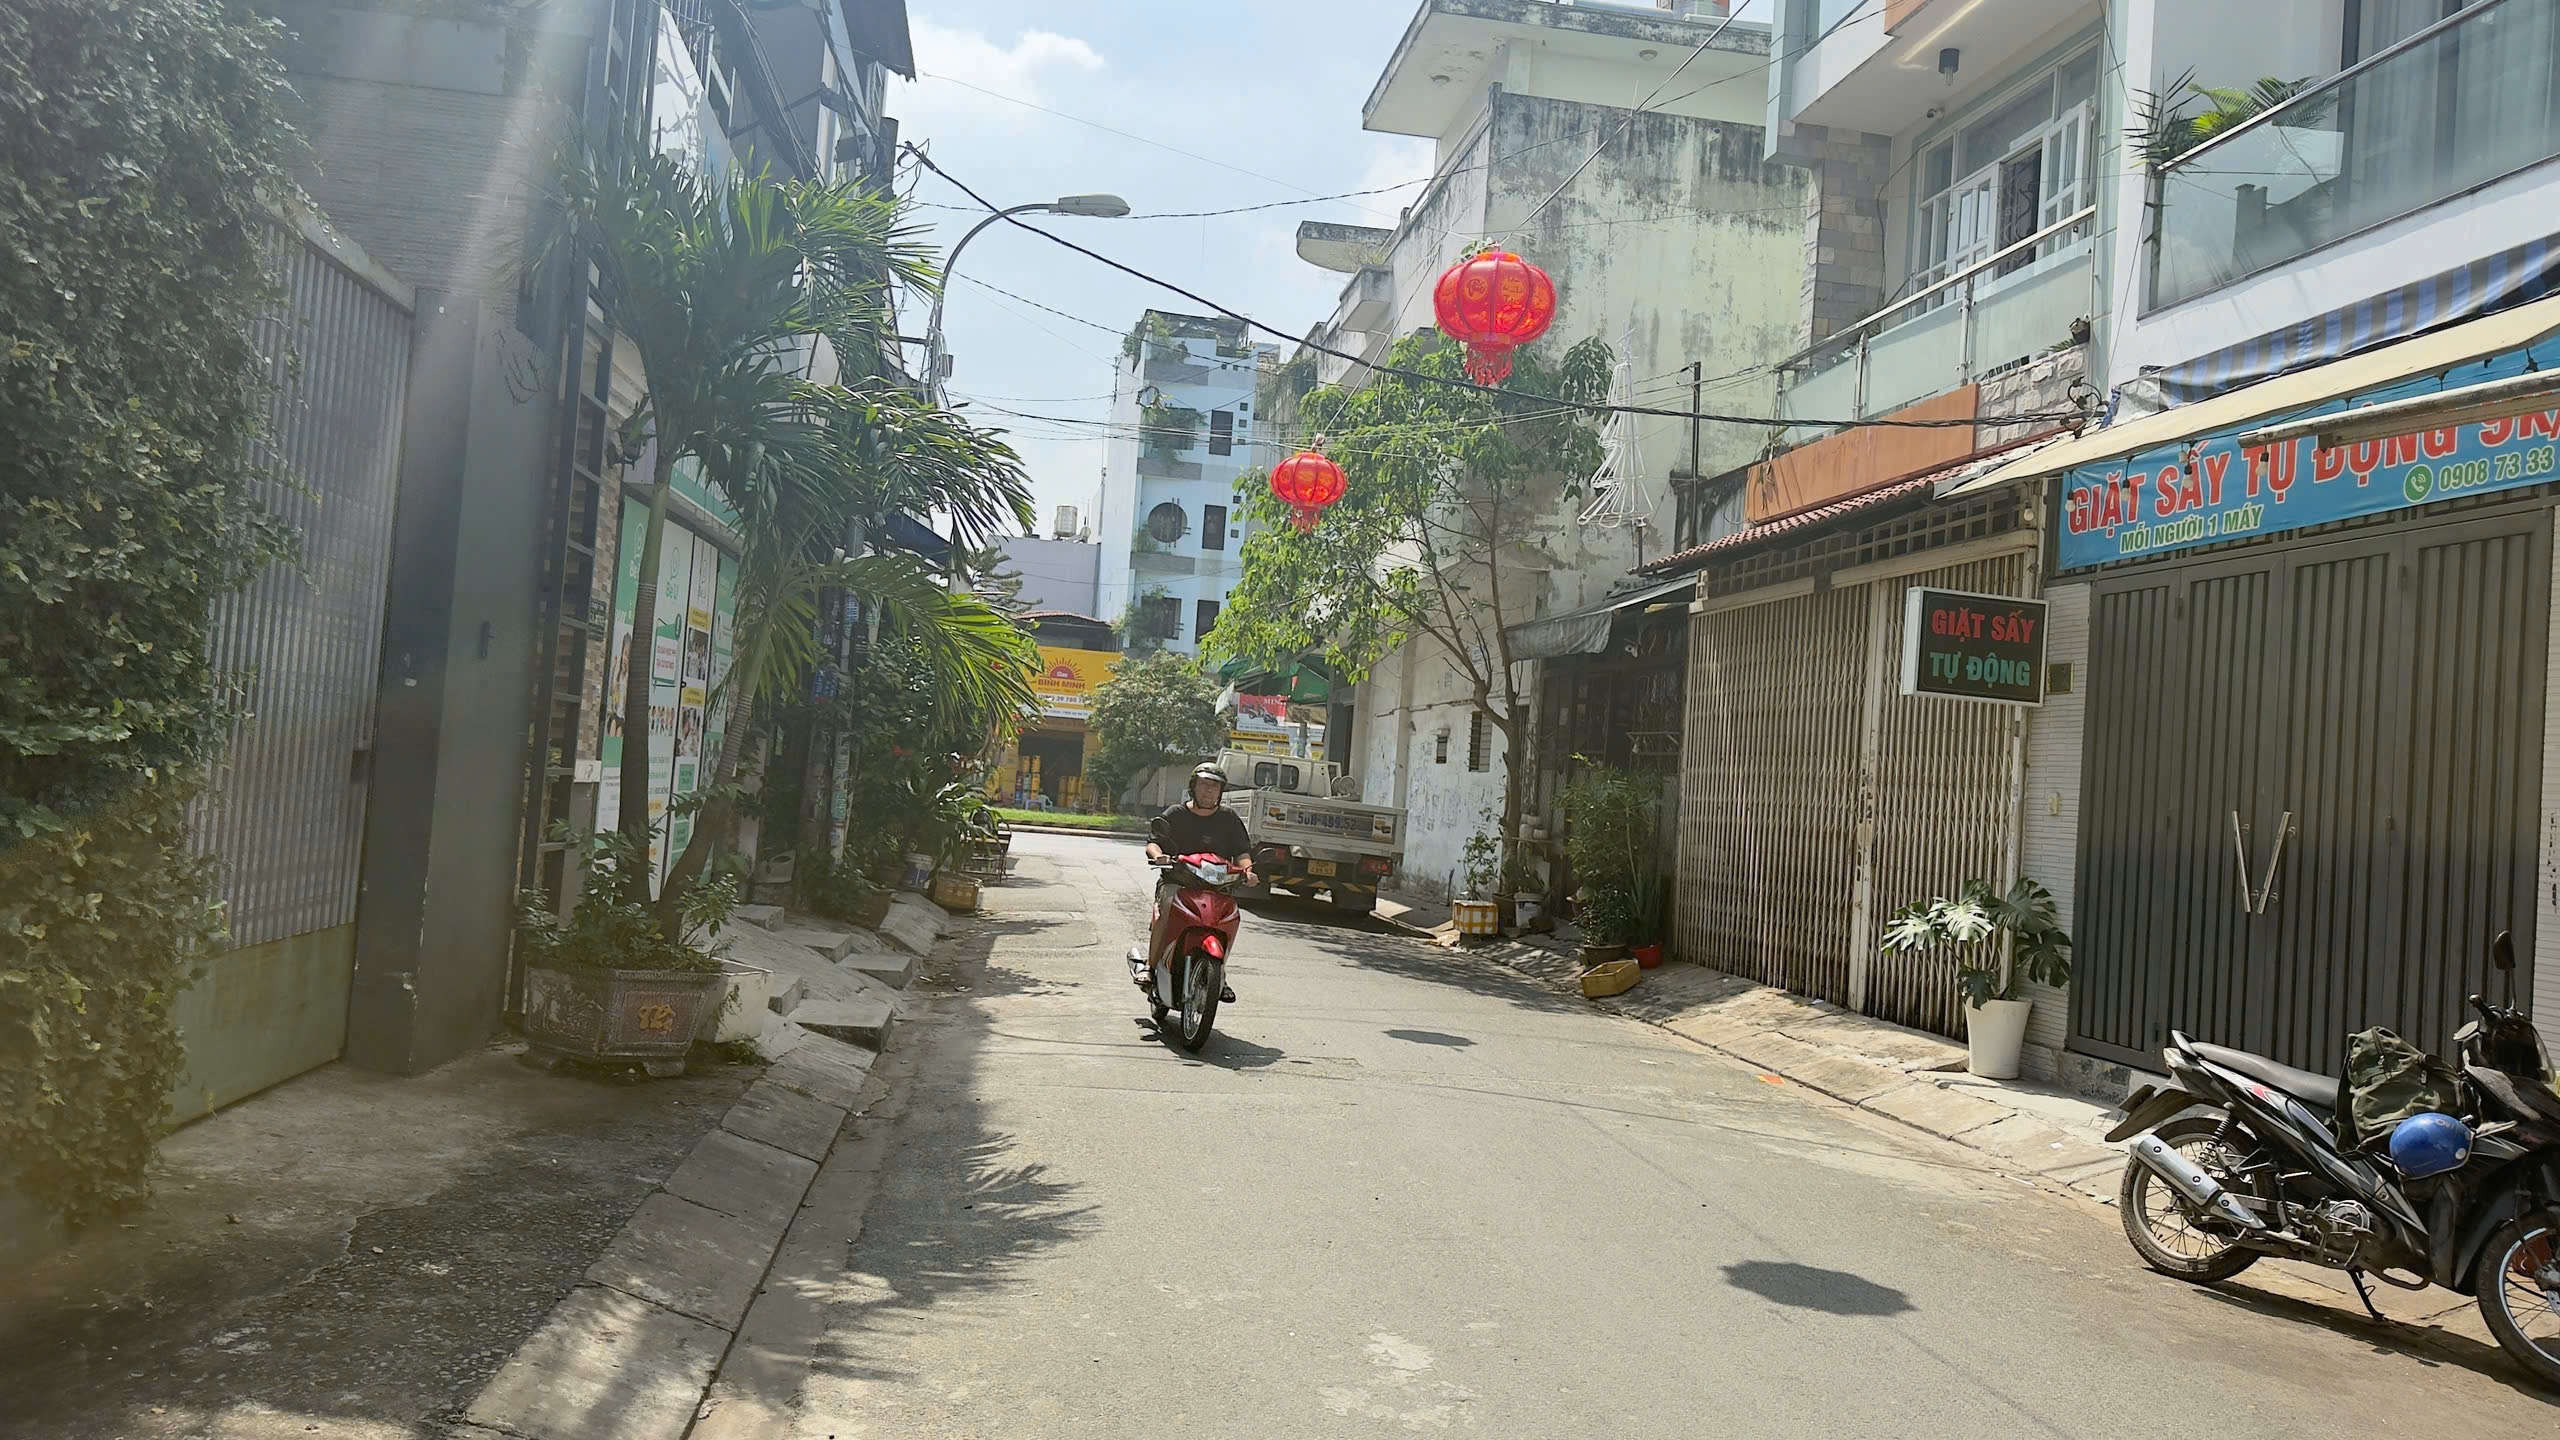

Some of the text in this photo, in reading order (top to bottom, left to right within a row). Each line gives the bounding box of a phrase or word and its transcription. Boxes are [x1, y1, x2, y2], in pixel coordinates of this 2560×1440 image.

[2068, 470, 2146, 538] GIẶT
[2155, 440, 2231, 518] SẤY
[2439, 445, 2555, 491] 0908 73 33
[2120, 503, 2264, 553] MỖI NGƯỜI 1 MÁY
[1931, 607, 2035, 643] GIẶT SẤY
[1062, 681, 1085, 689] MINH
[1930, 650, 2031, 688] TỰ ĐỘNG
